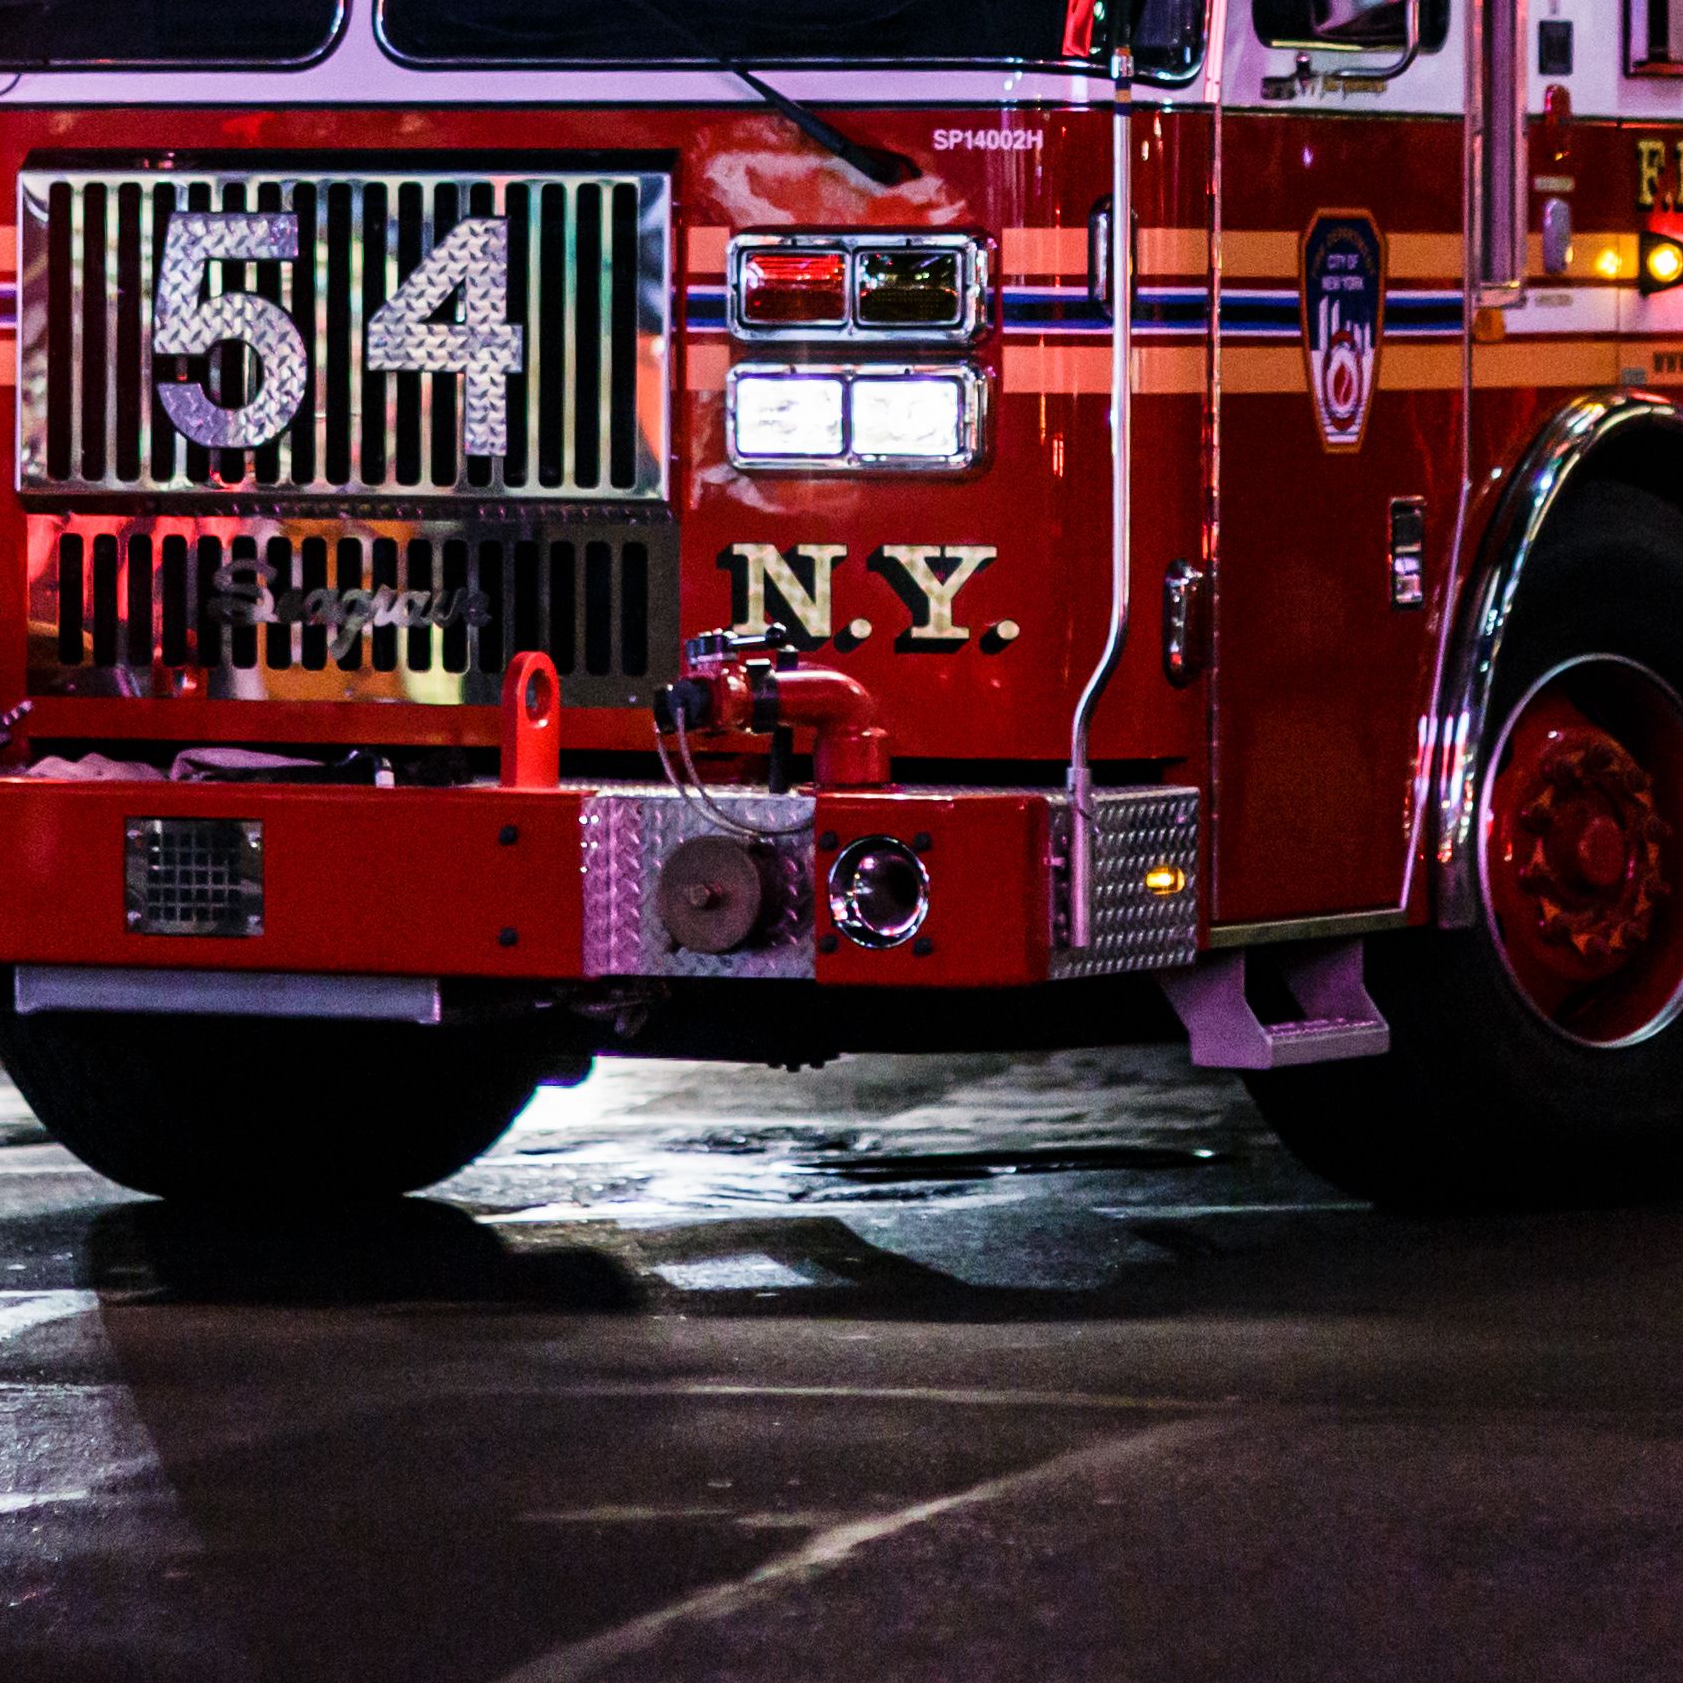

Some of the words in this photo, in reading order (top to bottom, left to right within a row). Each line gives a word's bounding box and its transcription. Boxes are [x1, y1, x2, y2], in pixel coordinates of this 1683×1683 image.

[932, 128, 1044, 152] SP14002H
[153, 211, 524, 458] 54
[731, 543, 1020, 640] N.Y.
